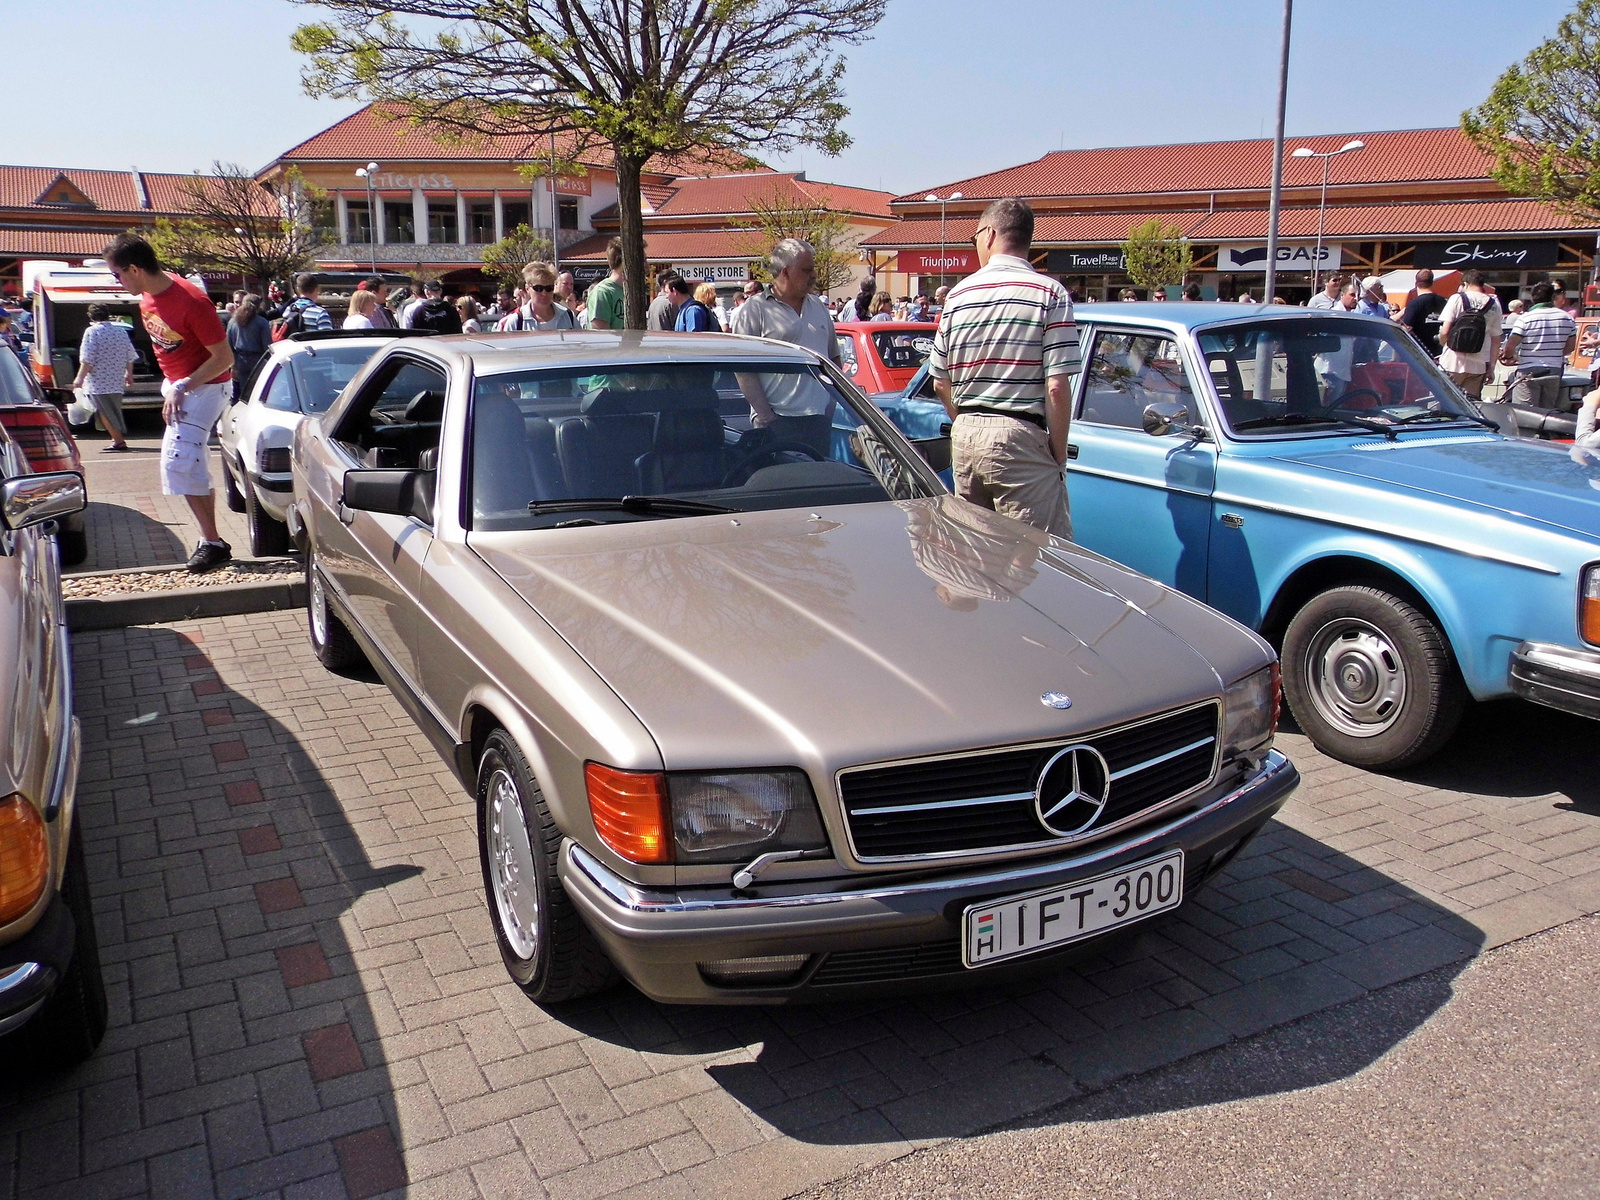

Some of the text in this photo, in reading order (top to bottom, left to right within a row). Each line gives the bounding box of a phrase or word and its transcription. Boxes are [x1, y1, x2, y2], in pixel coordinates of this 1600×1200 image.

[1070, 254, 1118, 266] Travel Bags
[1276, 246, 1330, 261] GAS
[1441, 242, 1528, 265] Skiny
[919, 256, 960, 269] Triumph
[676, 267, 744, 278] The SHOE STORE
[1018, 864, 1175, 946] IFT-300
[977, 935, 994, 957] H
